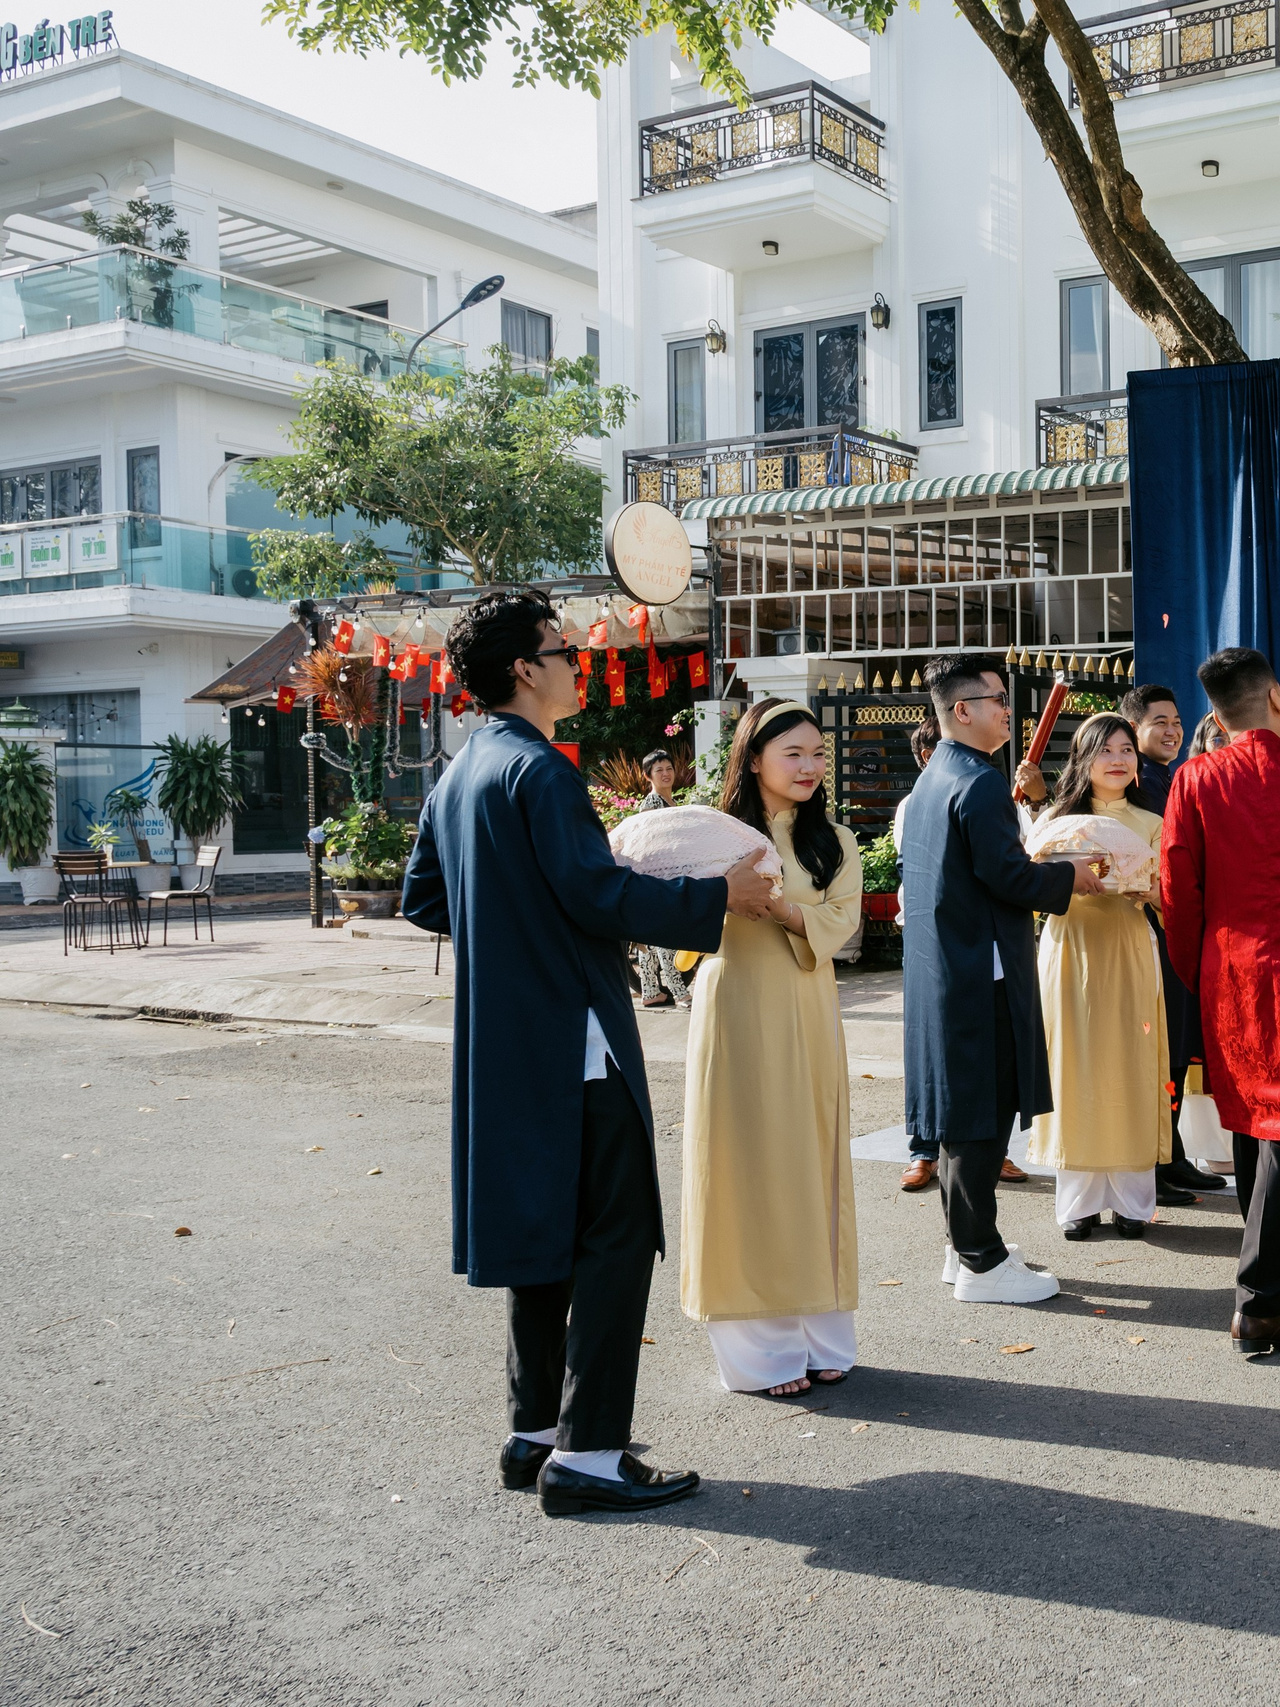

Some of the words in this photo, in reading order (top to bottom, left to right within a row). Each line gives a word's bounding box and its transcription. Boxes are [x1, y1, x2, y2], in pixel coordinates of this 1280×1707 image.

[19, 18, 63, 65] BẾN
[68, 10, 113, 50] TRE
[635, 570, 673, 588] ANGEL
[146, 828, 164, 836] EDU
